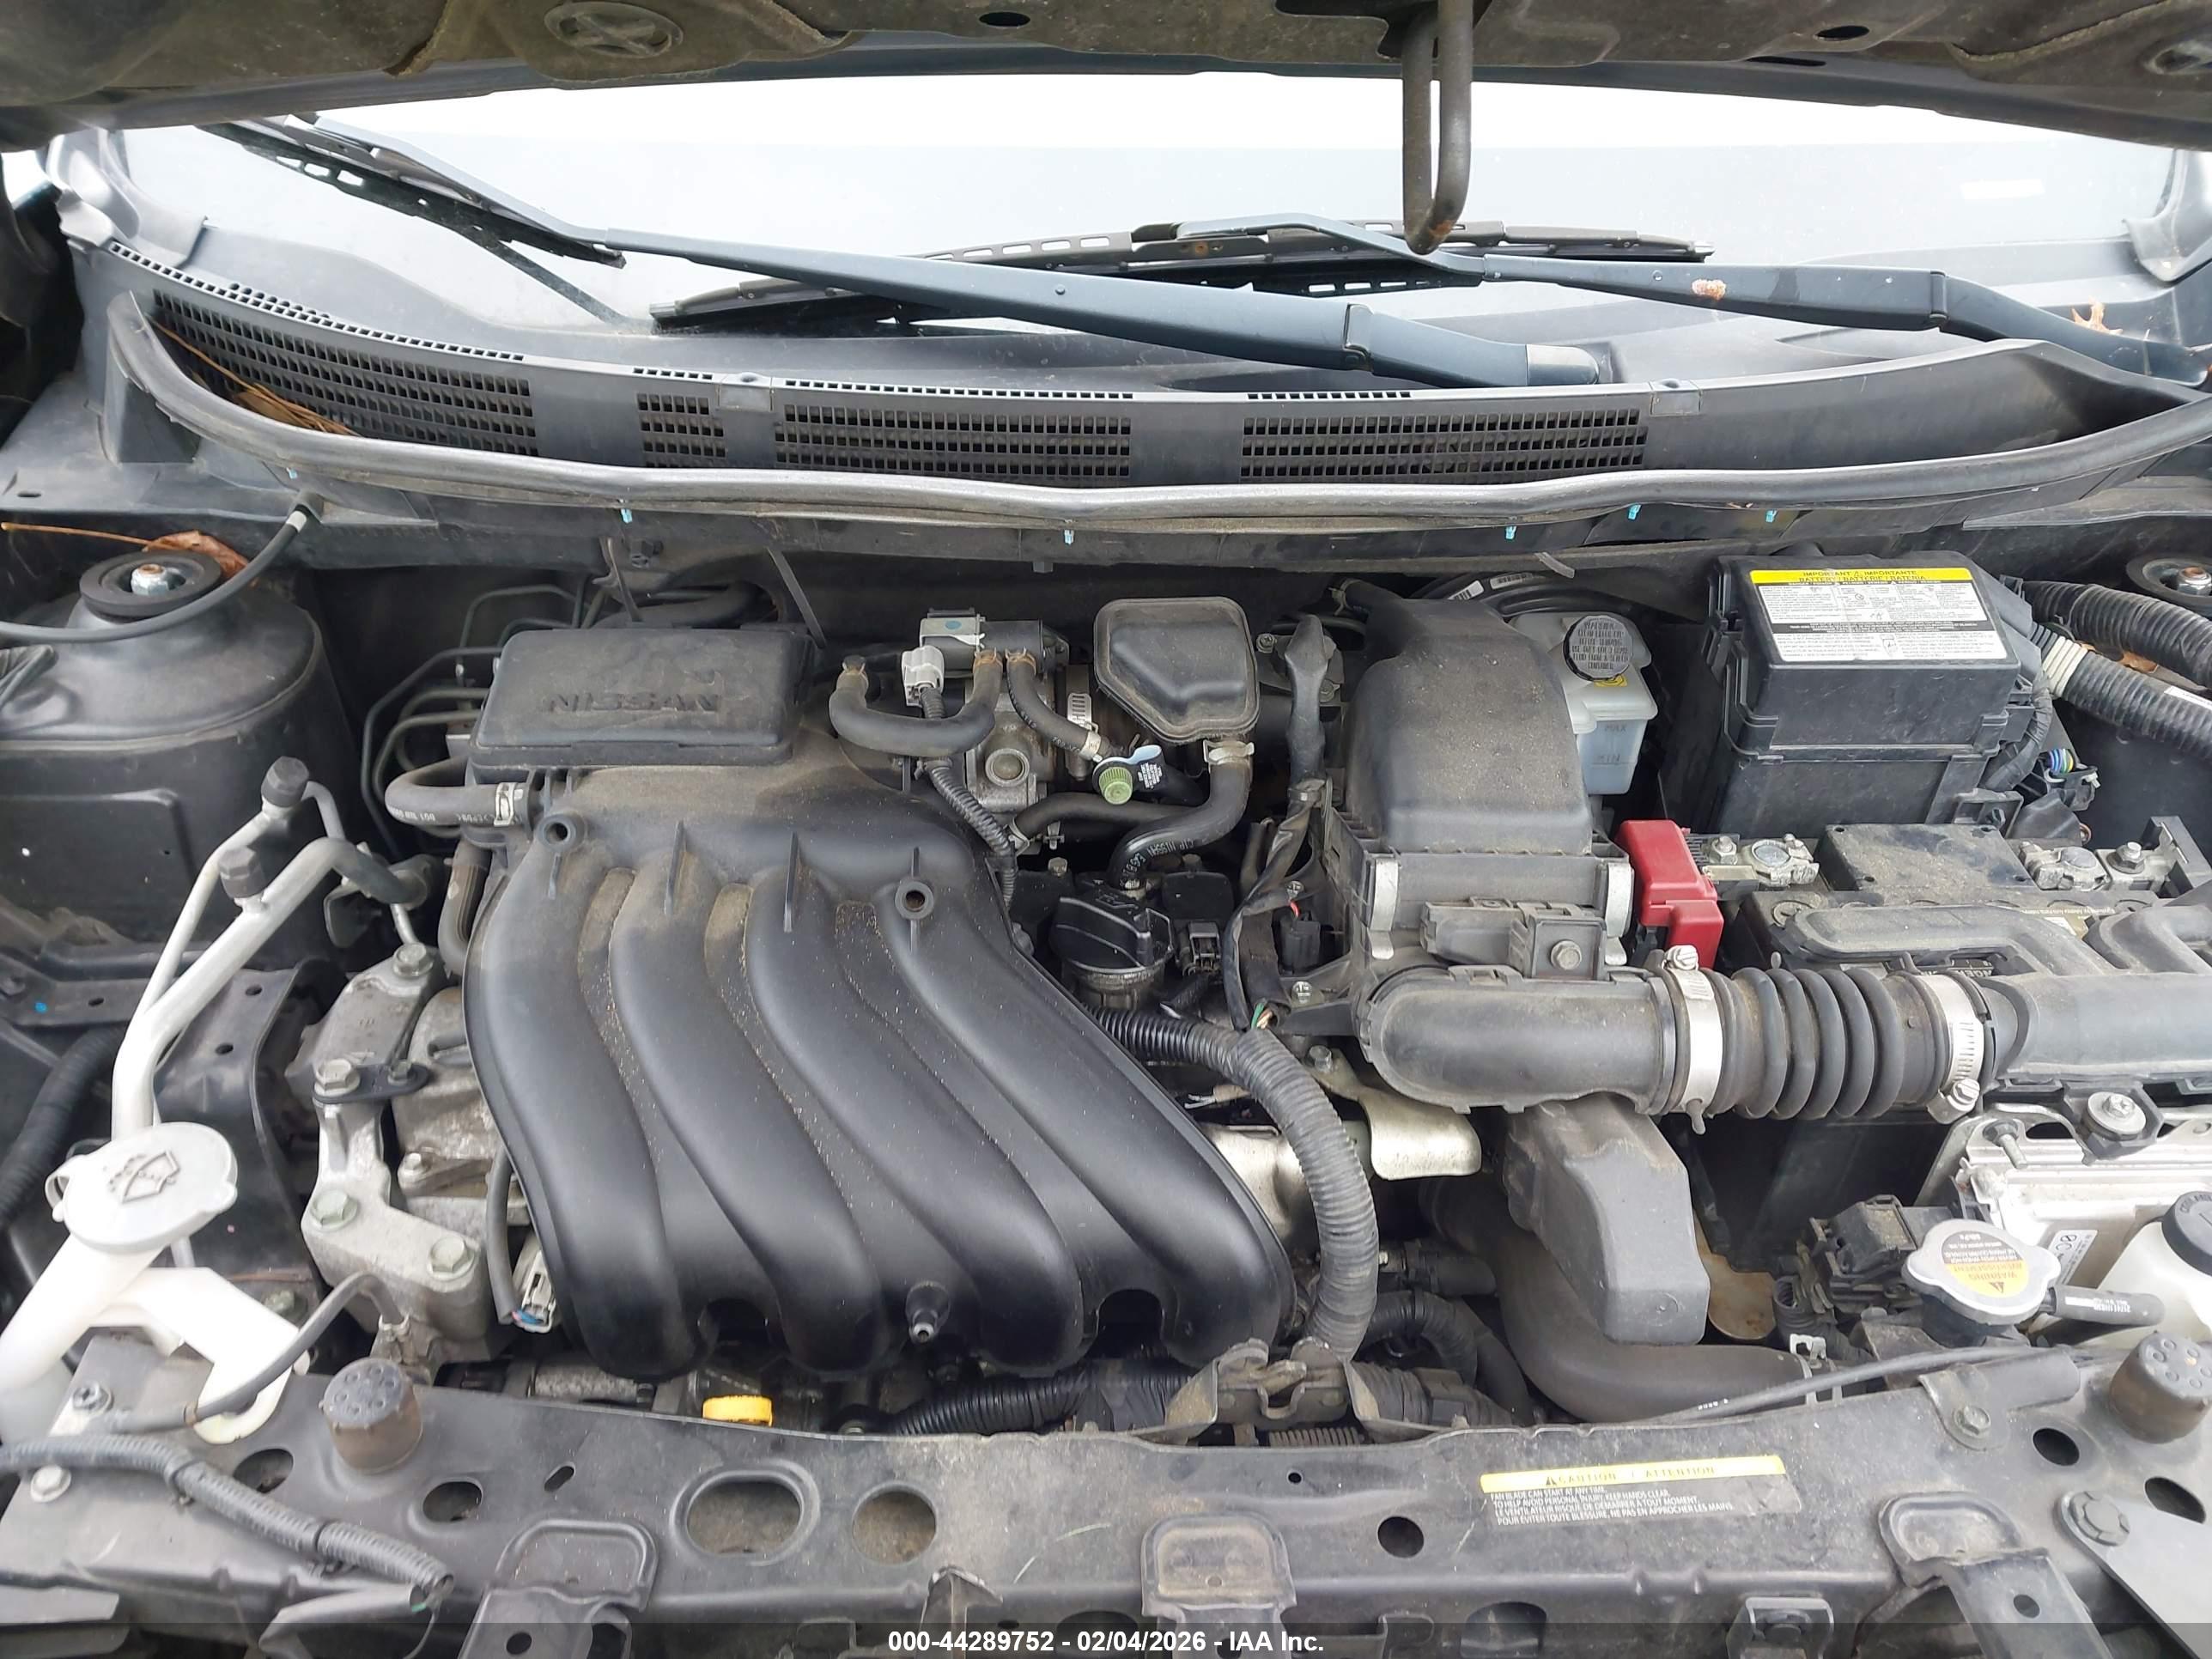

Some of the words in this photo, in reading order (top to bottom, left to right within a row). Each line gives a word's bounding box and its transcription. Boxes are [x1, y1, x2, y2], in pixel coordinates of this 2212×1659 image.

[547, 692, 720, 713] NISSAN
[1559, 1473, 1616, 1484] CAUTION
[1646, 1466, 1715, 1478] ATTENTION
[1504, 1499, 1521, 1508] HELP
[1522, 1498, 1543, 1507] AVOID
[1544, 1496, 1577, 1505] PERSONAL
[1621, 1491, 1646, 1499] HANDS
[1642, 1498, 1662, 1506] TOUT
[1497, 1516, 1519, 1526] POUR
[1547, 1512, 1571, 1522] TOUTE
[1621, 1508, 1637, 1516] PAS
[1648, 1504, 1694, 1515] APPROCHER
